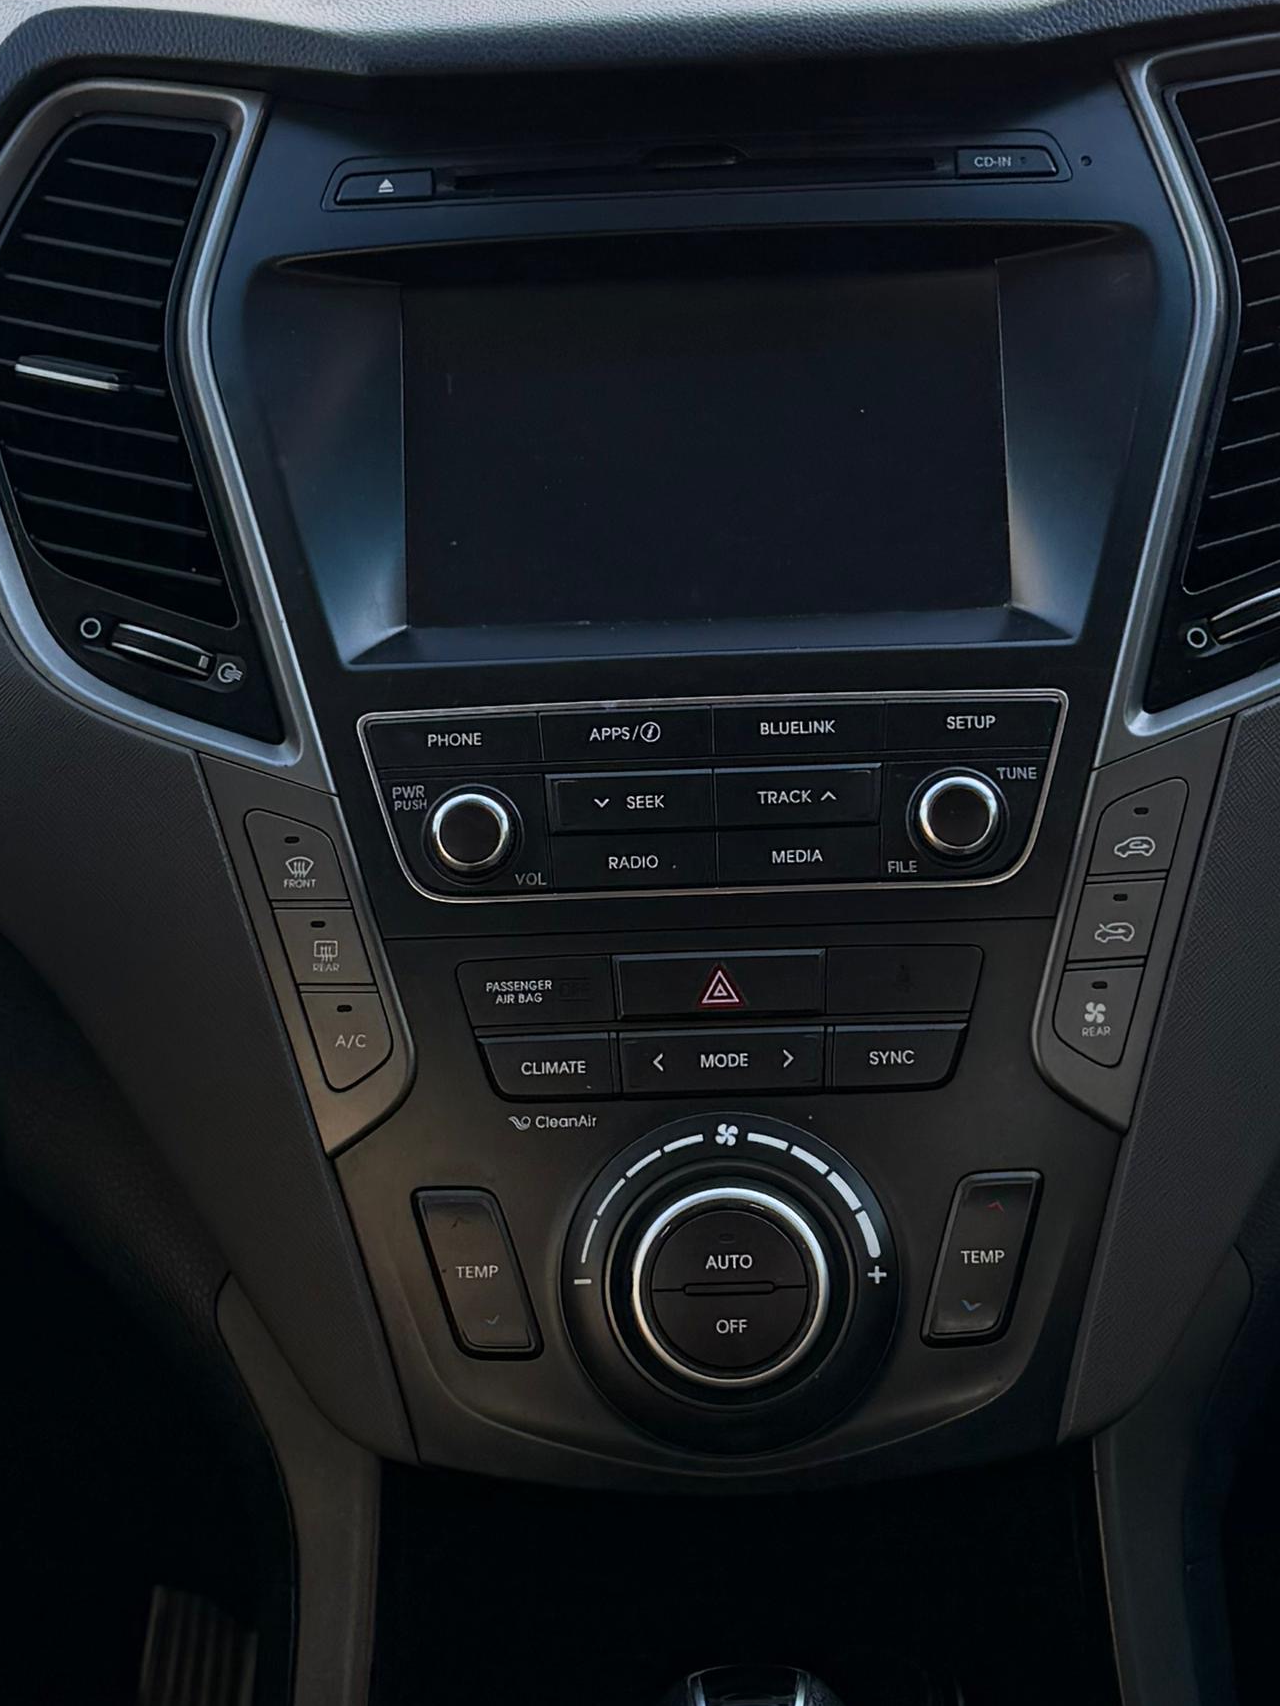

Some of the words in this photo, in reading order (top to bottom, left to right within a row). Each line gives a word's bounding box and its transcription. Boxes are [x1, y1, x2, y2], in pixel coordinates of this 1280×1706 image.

[759, 719, 835, 736] BLUELINK
[946, 714, 997, 730] SETUP
[427, 732, 482, 747] PHONE
[996, 767, 1038, 781] TUNE
[392, 786, 426, 799] PWR
[757, 789, 812, 805] TRACK
[394, 799, 428, 811] PUSH
[626, 794, 665, 810] SEEK
[608, 854, 659, 870] RADIO
[771, 849, 823, 864] MEDIA
[887, 859, 918, 874] FILE
[283, 878, 317, 889] FRONT
[514, 871, 548, 886] VOL
[485, 979, 553, 992] PASSENGER
[494, 993, 516, 1004] AIR
[517, 992, 543, 1004] BAG
[1081, 1025, 1111, 1037] REAR
[334, 1034, 366, 1049] A/C
[700, 1052, 748, 1068] MODE
[869, 1049, 915, 1066] SYNC
[520, 1060, 586, 1076] CLIMATE
[534, 1114, 597, 1129] CleanAir
[705, 1254, 753, 1270] AUTO
[960, 1249, 1005, 1264] TEMP
[456, 1264, 499, 1279] TEMP
[715, 1318, 747, 1334] OFF
